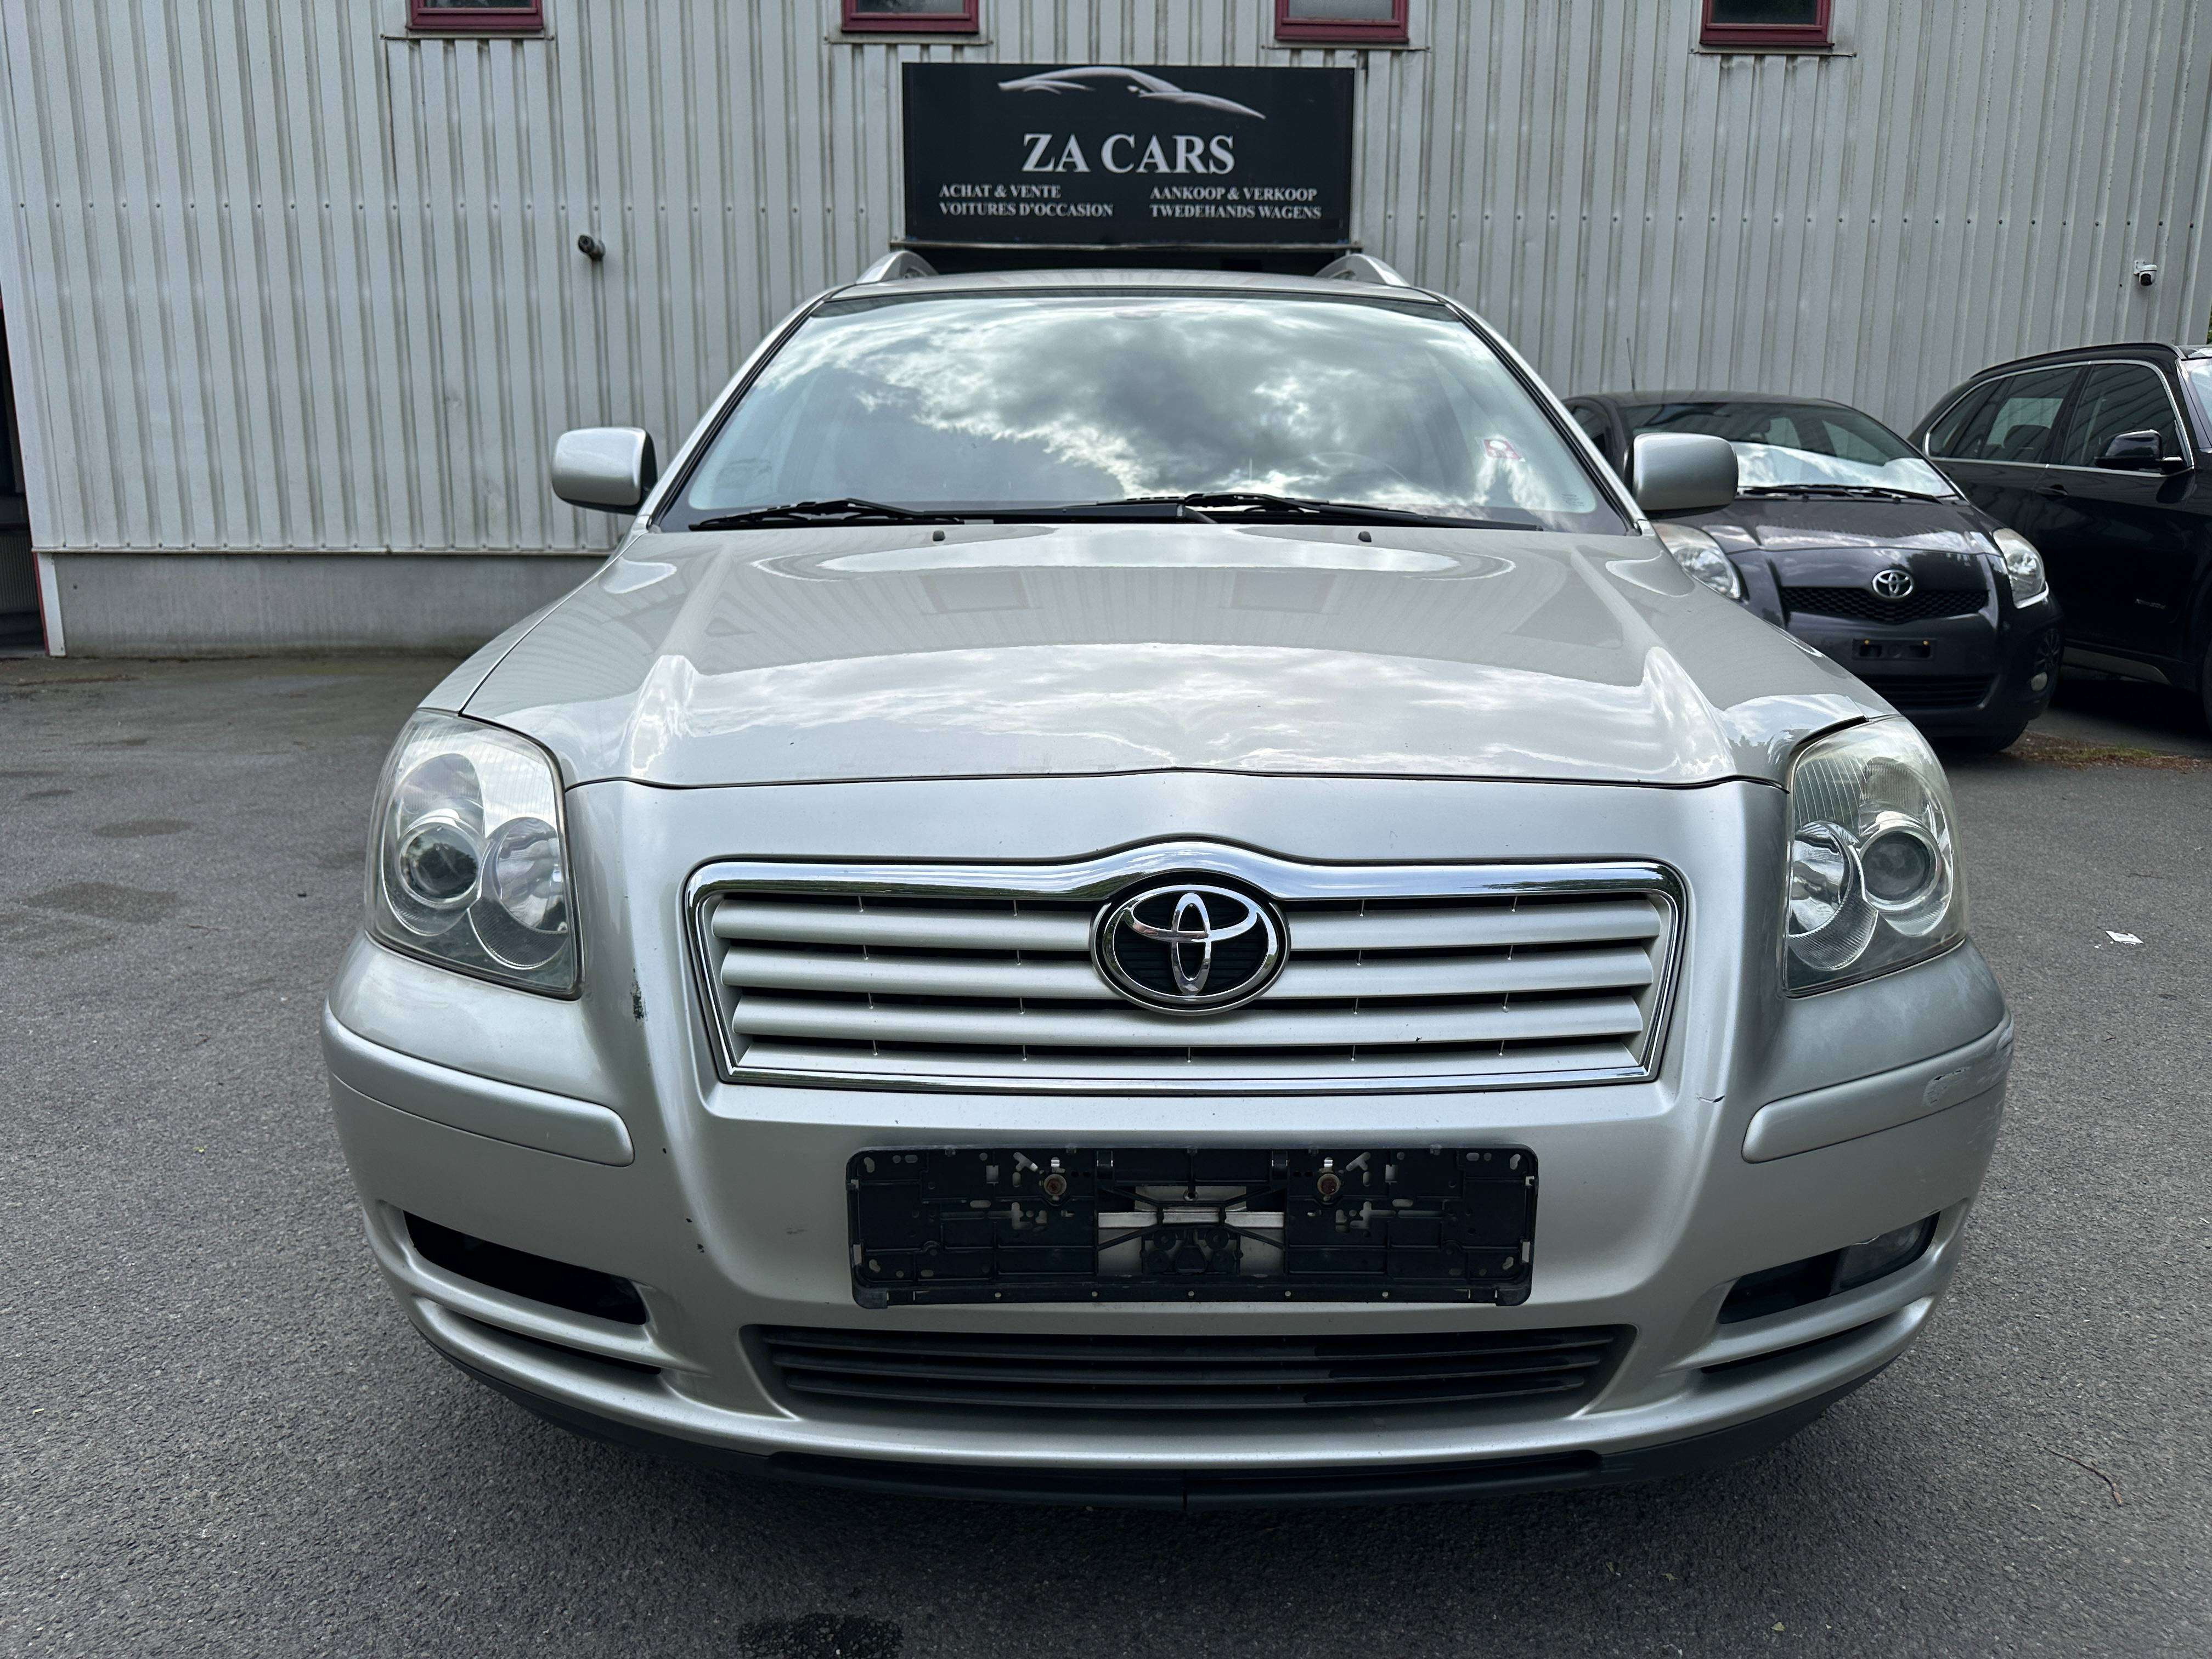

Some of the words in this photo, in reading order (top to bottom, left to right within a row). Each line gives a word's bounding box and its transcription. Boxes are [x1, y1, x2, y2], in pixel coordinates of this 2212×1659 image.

[1022, 133, 1091, 173] ZA
[1101, 133, 1235, 174] CARS
[939, 184, 992, 198] ACHAT
[994, 184, 1007, 198] &
[1010, 184, 1061, 199] VENTE
[1150, 186, 1226, 200] AANKOOP
[1227, 187, 1240, 200] &
[1243, 187, 1317, 201] VERKOOP
[939, 202, 1016, 216] VOITURES
[1019, 202, 1113, 217] D'OCCASION
[1149, 204, 1256, 218] TWEDEHANDS
[1258, 205, 1322, 219] WAGENS
